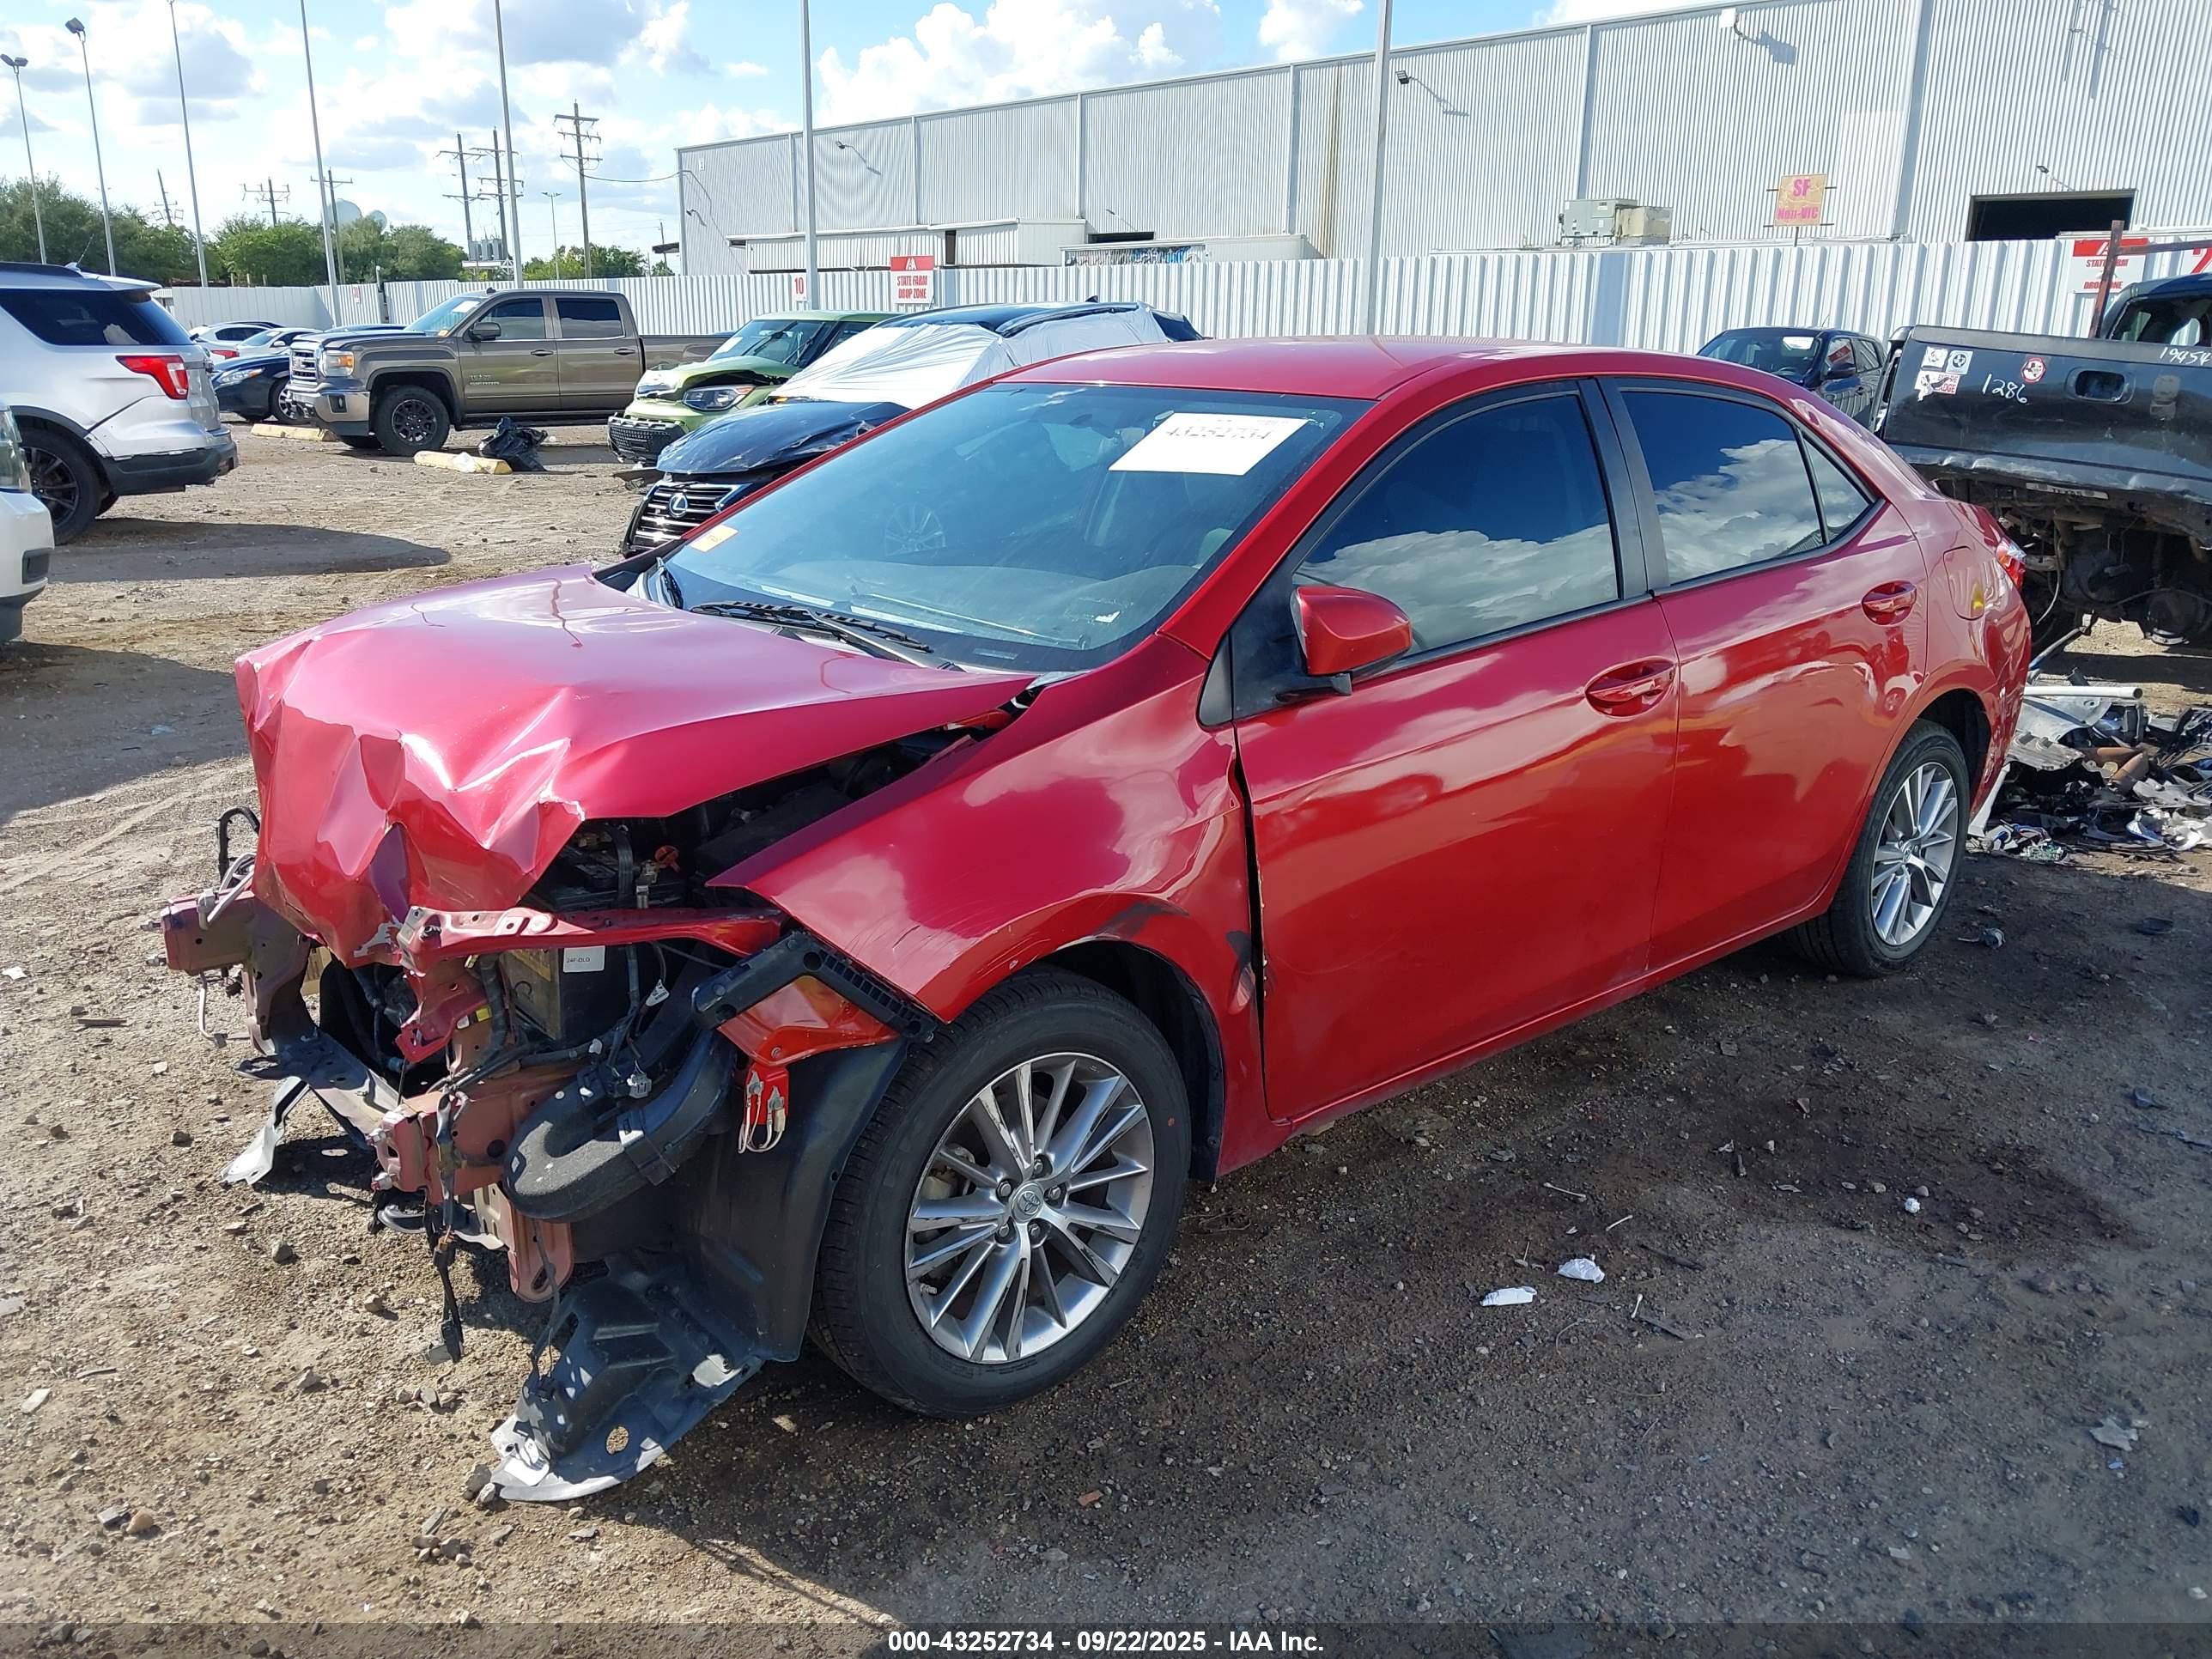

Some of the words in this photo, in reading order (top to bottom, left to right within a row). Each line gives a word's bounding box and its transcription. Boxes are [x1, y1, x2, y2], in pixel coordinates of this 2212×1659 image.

[1794, 179, 1810, 196] SF
[795, 275, 804, 294] 10
[896, 276, 912, 286] STATE
[912, 276, 928, 286] FARM
[898, 288, 913, 299] DROP
[913, 288, 927, 299] ZONE
[1982, 374, 2028, 404] 1286
